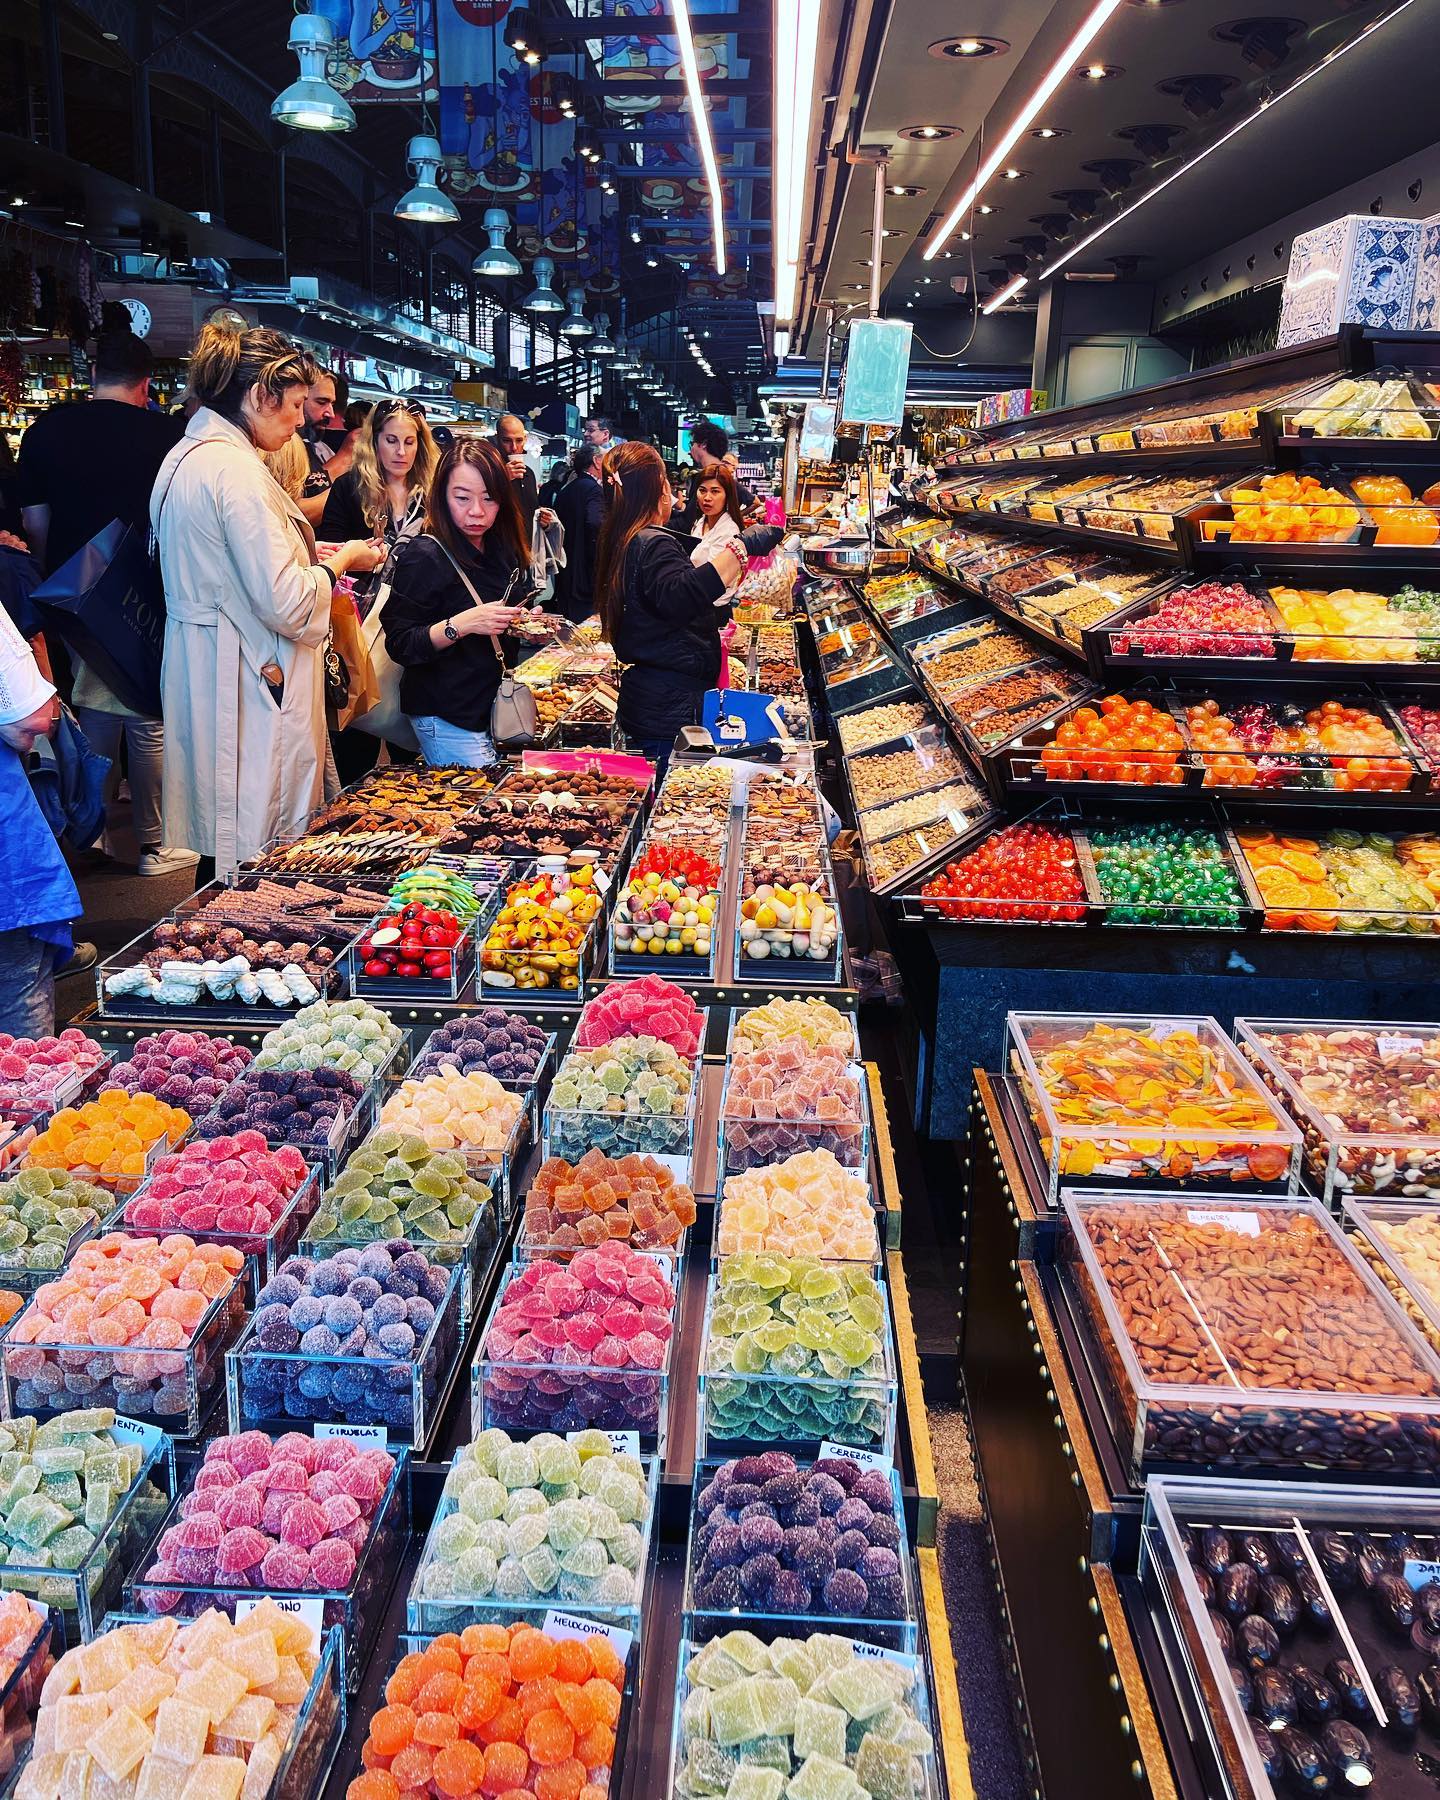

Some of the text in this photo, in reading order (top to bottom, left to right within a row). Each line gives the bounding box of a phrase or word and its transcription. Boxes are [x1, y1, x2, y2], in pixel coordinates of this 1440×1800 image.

[328, 1427, 379, 1437] CIRUELAS
[829, 1446, 873, 1463] CEREZAS
[852, 1643, 884, 1658] KIWI
